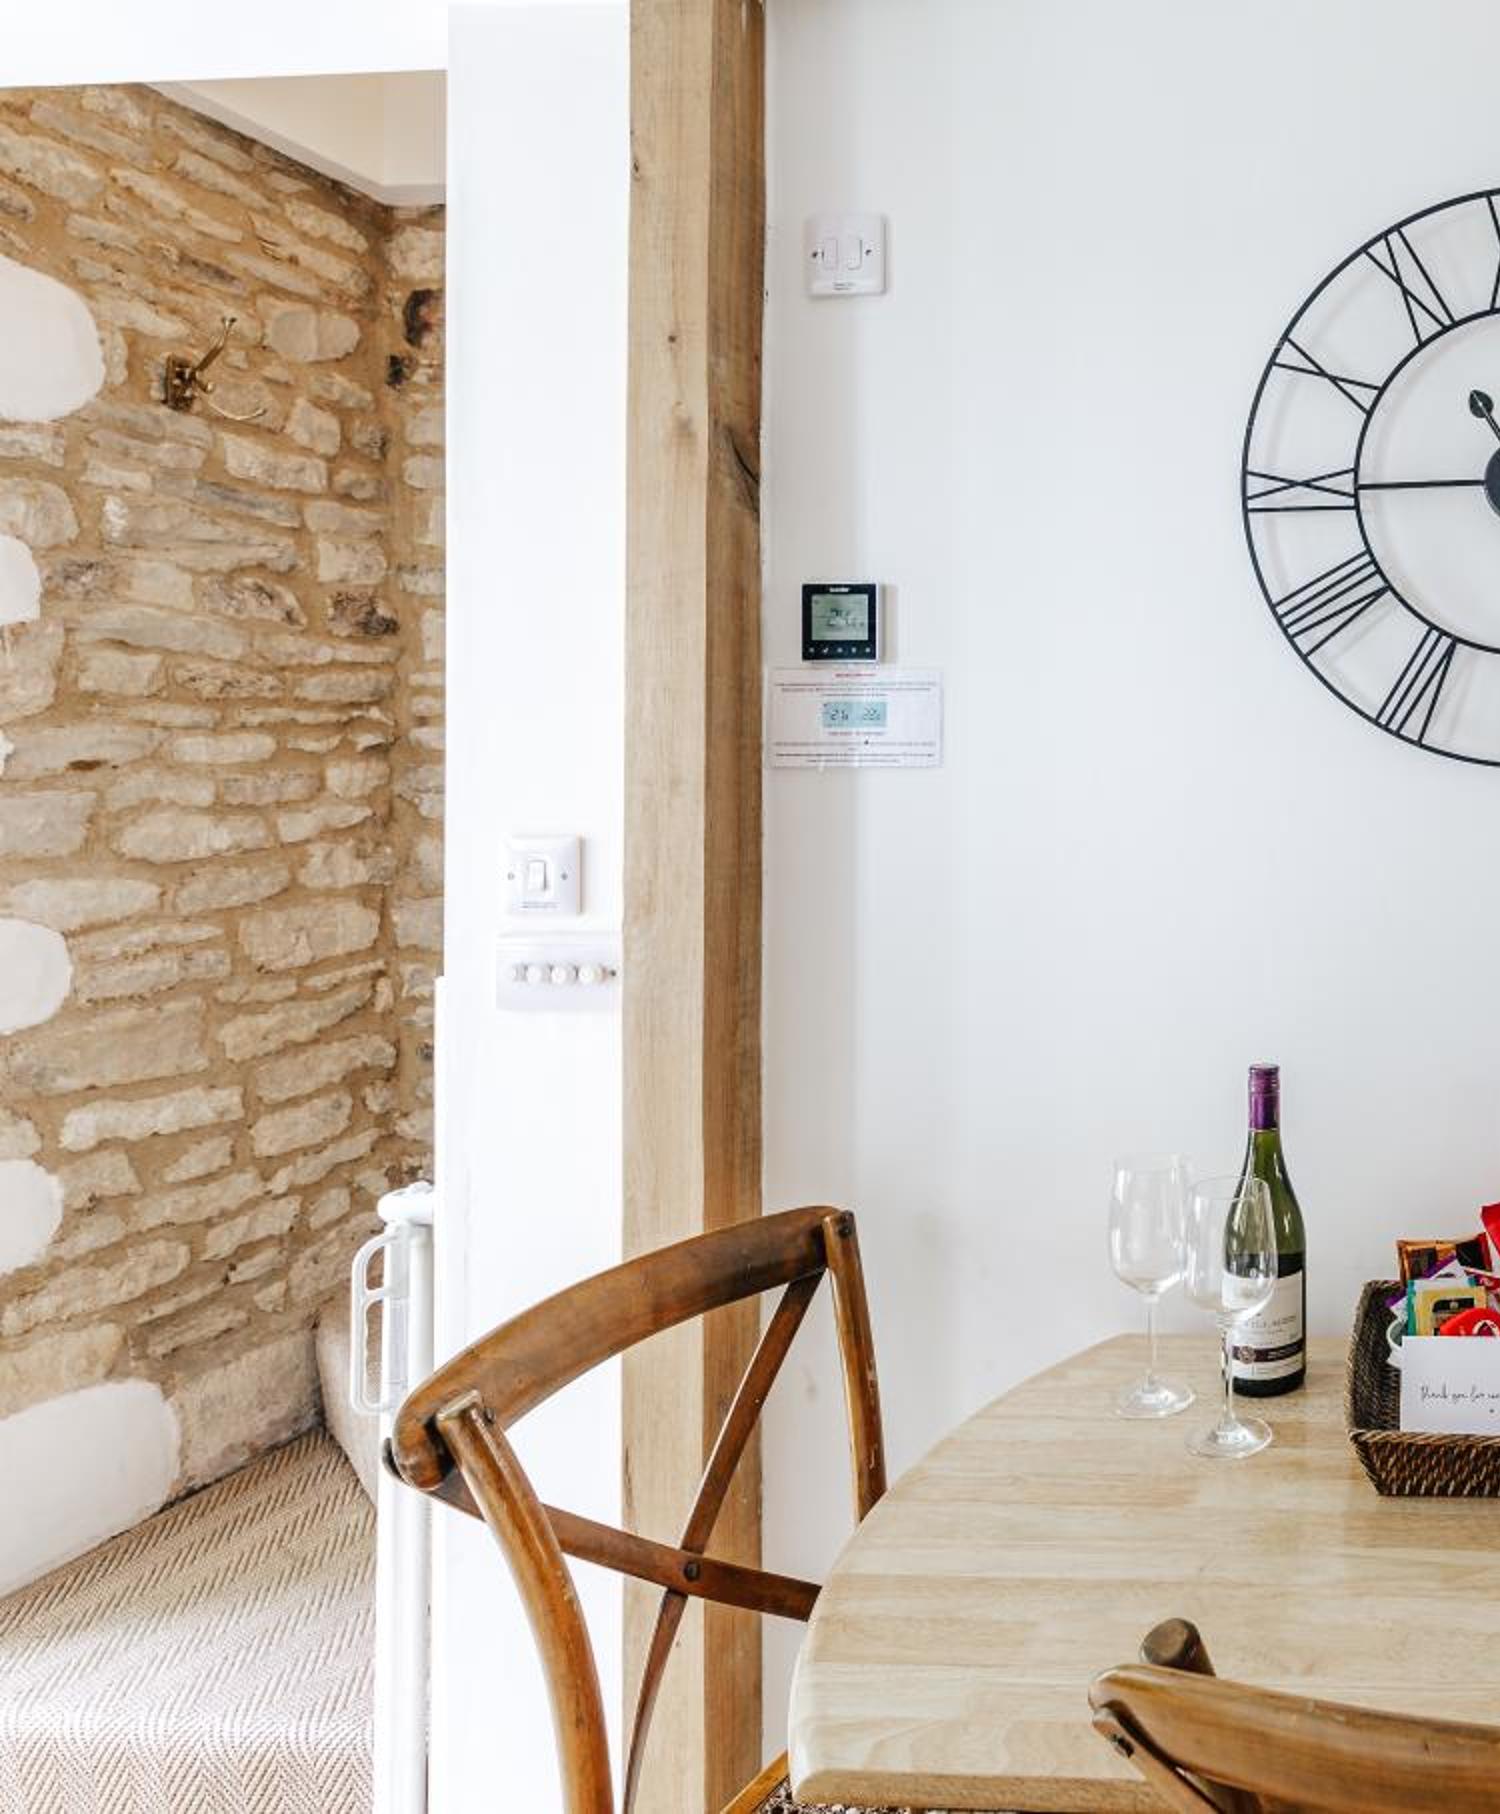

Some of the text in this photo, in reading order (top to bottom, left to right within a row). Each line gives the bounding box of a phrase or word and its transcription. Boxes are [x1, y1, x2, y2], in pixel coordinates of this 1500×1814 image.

[1363, 226, 1456, 346] XI
[1271, 337, 1382, 414] X
[1246, 468, 1357, 512] IX
[1273, 550, 1391, 656] VIII
[1374, 625, 1458, 746] VII
